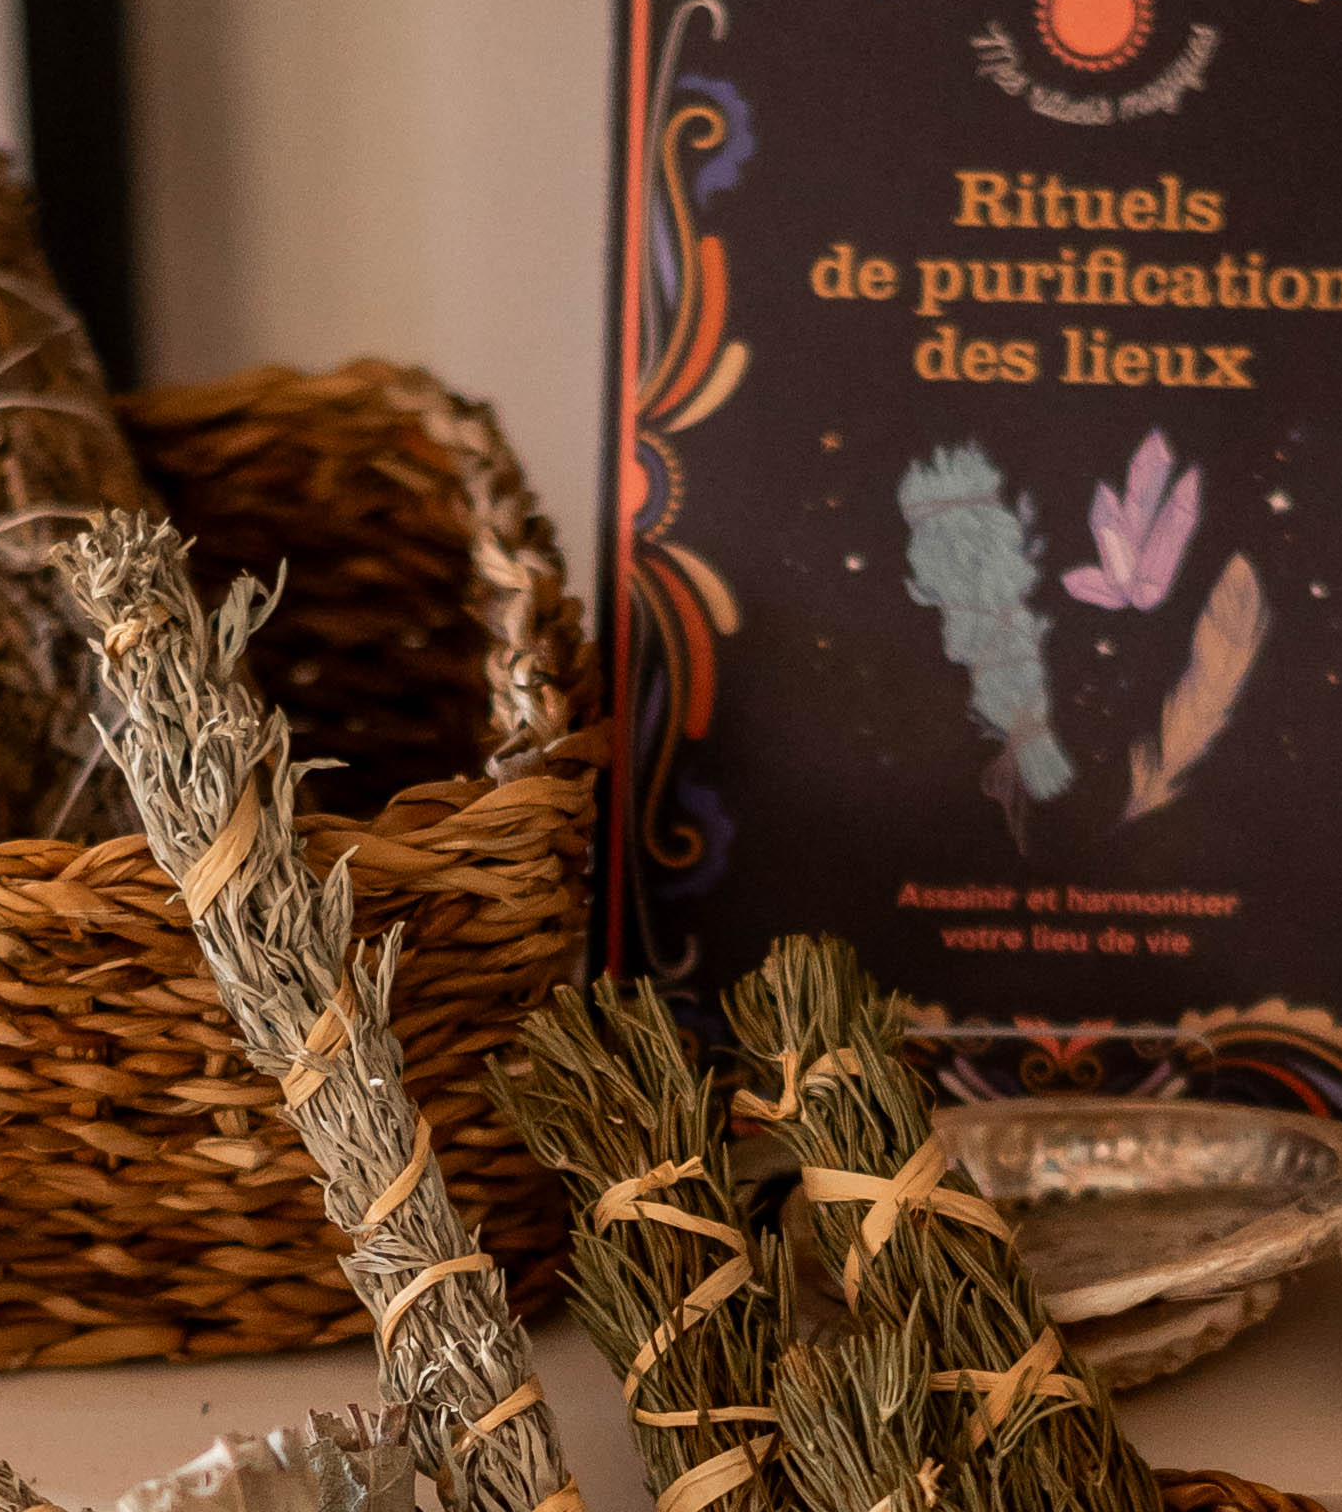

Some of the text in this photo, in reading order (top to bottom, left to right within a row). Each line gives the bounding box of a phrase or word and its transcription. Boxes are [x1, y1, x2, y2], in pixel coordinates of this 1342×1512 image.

[953, 170, 1223, 233] Rituels
[810, 243, 897, 301] de
[913, 324, 1255, 388] des lieux
[1026, 888, 1059, 913] et
[1066, 885, 1239, 918] harmoniser
[940, 926, 1024, 952] votre
[1097, 926, 1137, 956] de
[1144, 928, 1192, 957] vie
